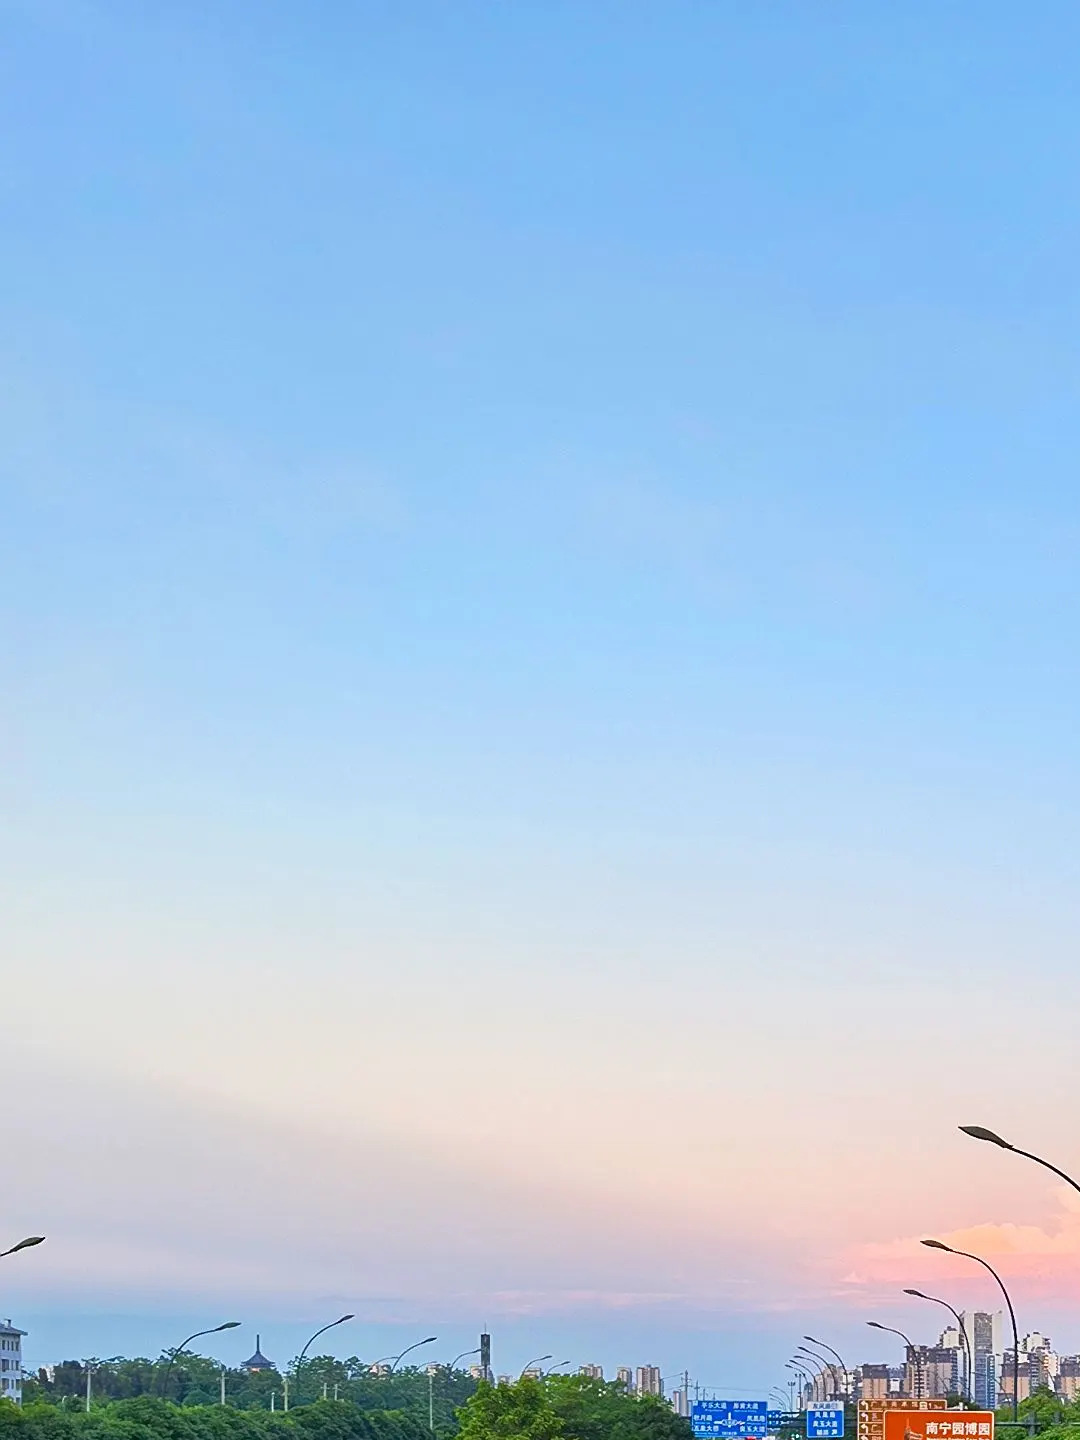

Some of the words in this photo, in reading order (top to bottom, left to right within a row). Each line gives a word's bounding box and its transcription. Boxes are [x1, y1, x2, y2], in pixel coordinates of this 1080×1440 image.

[925, 1421, 991, 1436] 南宁园博园
